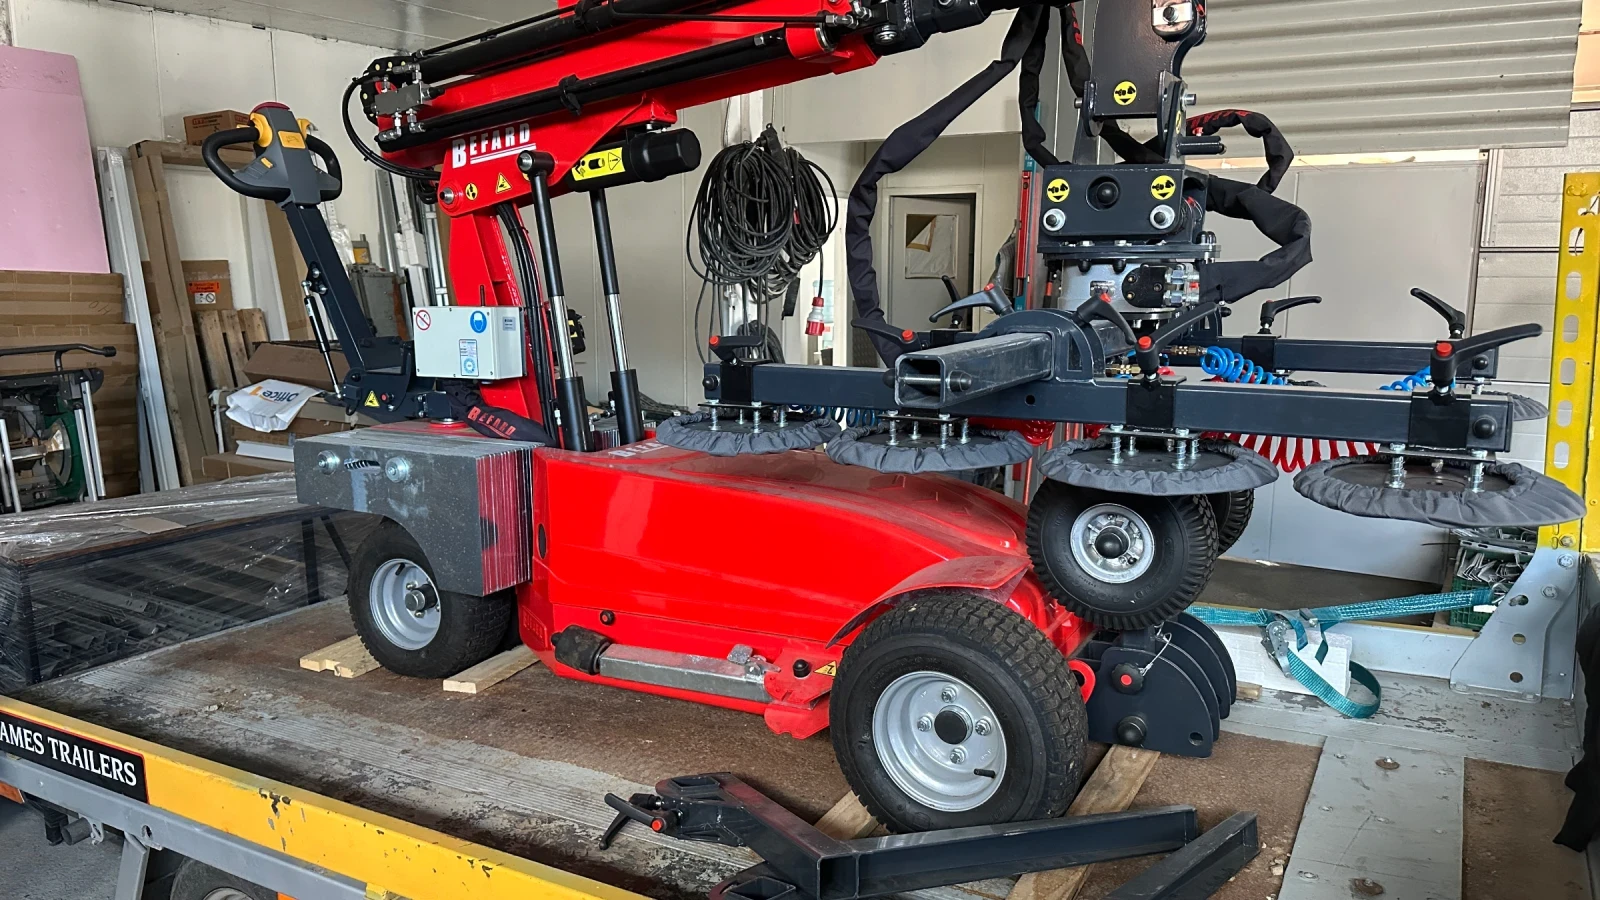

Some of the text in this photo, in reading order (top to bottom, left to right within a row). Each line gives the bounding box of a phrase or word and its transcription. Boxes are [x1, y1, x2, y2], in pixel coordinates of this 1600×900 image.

[452, 123, 531, 169] BEFARD
[261, 389, 299, 402] Office
[467, 405, 517, 437] BEFARD
[47, 736, 137, 787] TRAILERS
